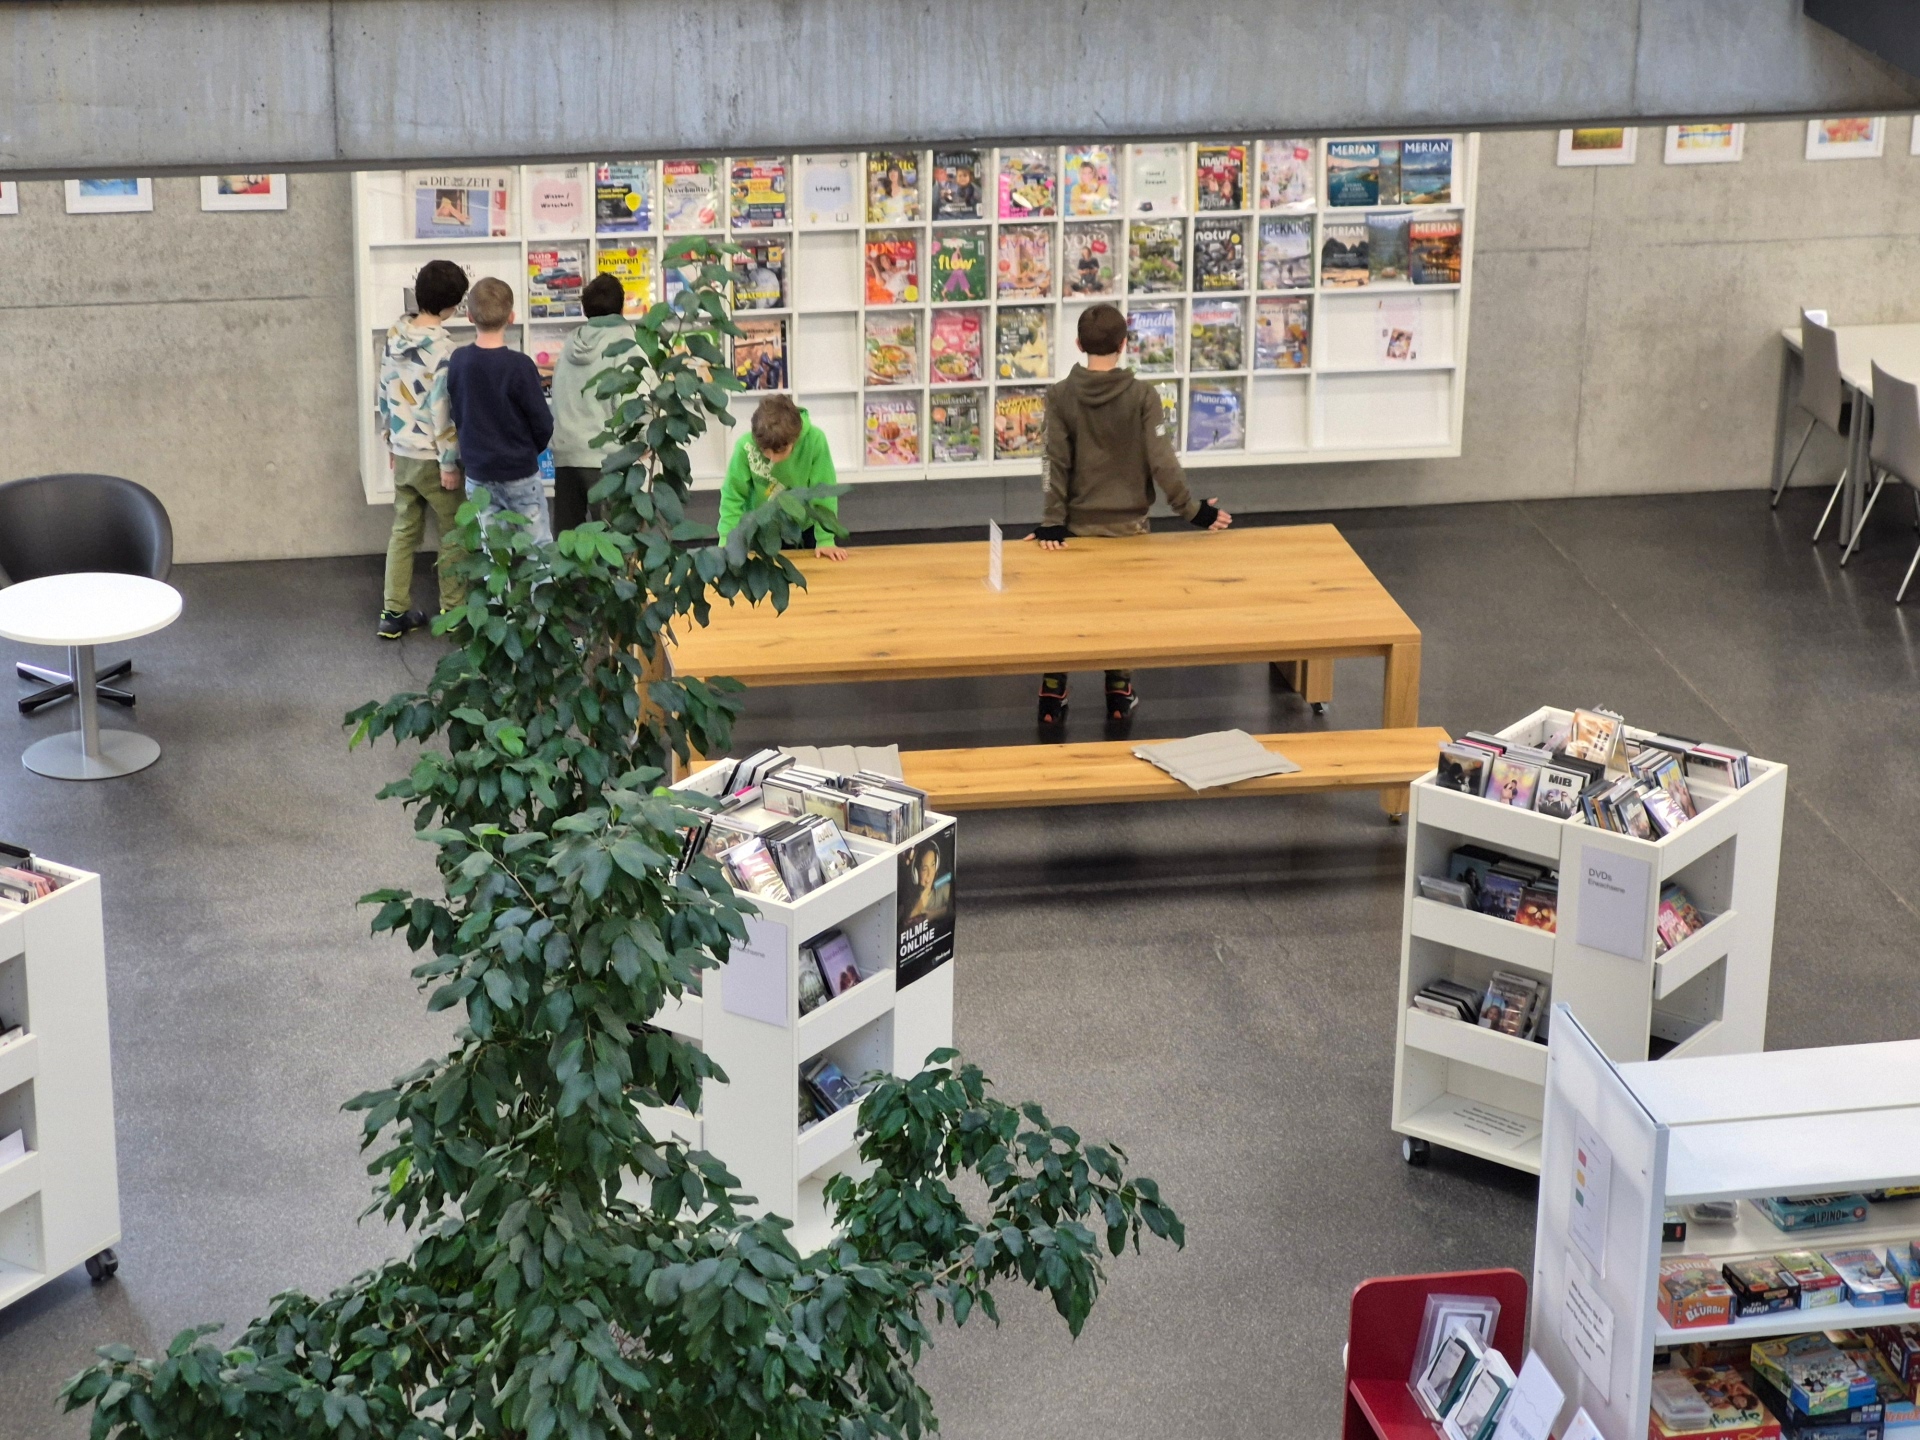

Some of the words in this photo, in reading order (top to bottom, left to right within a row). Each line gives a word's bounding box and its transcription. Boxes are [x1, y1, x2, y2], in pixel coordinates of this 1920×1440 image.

[1331, 144, 1376, 156] MERIAN
[1404, 142, 1449, 154] MERIAN
[936, 152, 973, 165] Family
[430, 176, 450, 186] DIE
[466, 177, 492, 188] ZEIT
[1262, 221, 1310, 235] TREKKING
[1322, 226, 1364, 236] MERIAN
[1416, 222, 1457, 234] MERIAN
[1195, 230, 1232, 240] natur
[598, 257, 638, 266] Finanzen
[938, 254, 974, 271] flow
[1548, 774, 1572, 788] MIB
[817, 826, 834, 843] 2040
[1588, 868, 1612, 882] DVDs
[900, 919, 929, 945] FILME
[900, 928, 936, 957] ONLINE
[1685, 1304, 1726, 1322] BLURBLE
